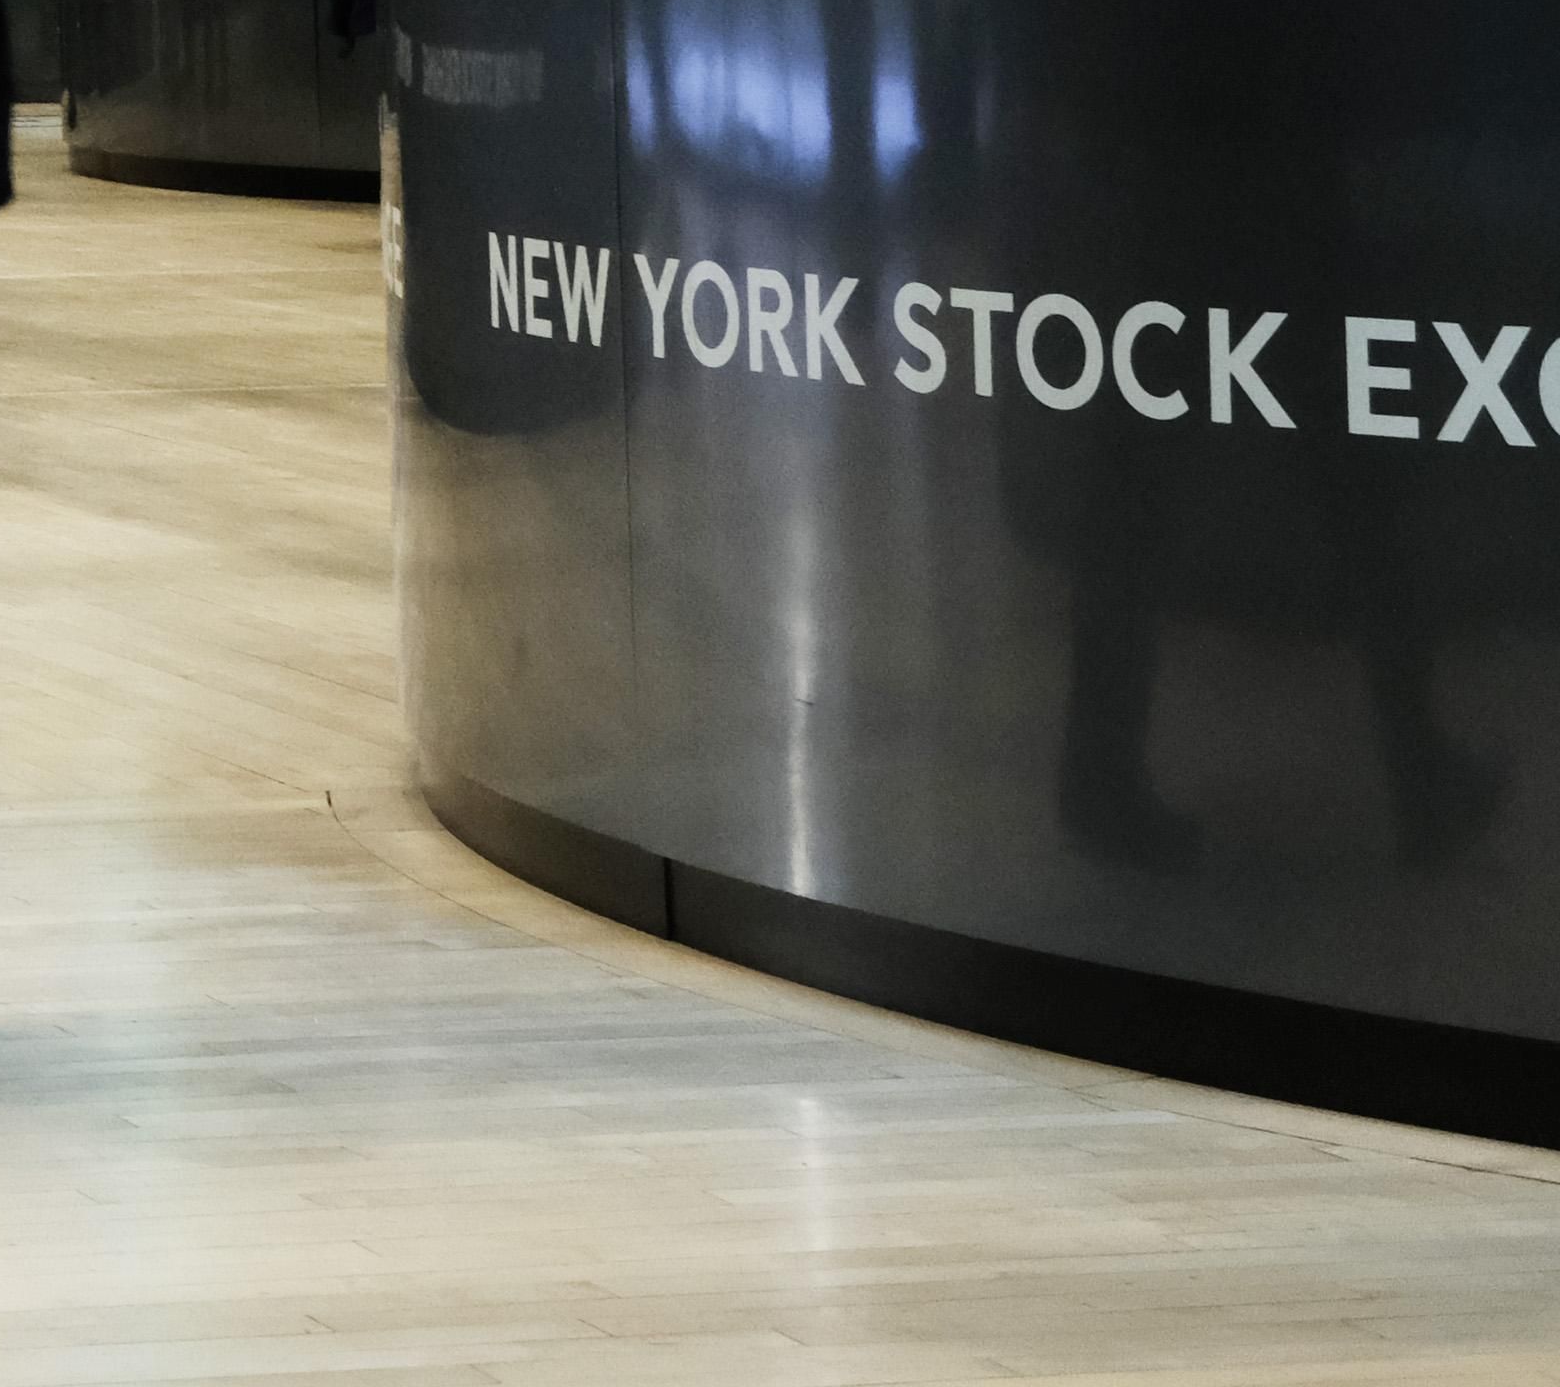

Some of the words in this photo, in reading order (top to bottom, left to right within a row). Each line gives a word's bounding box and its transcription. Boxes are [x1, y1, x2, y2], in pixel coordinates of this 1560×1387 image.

[487, 230, 611, 349] NEW
[633, 252, 866, 388] YORK
[892, 280, 1299, 431] STOCK
[1343, 314, 1560, 449] EX
